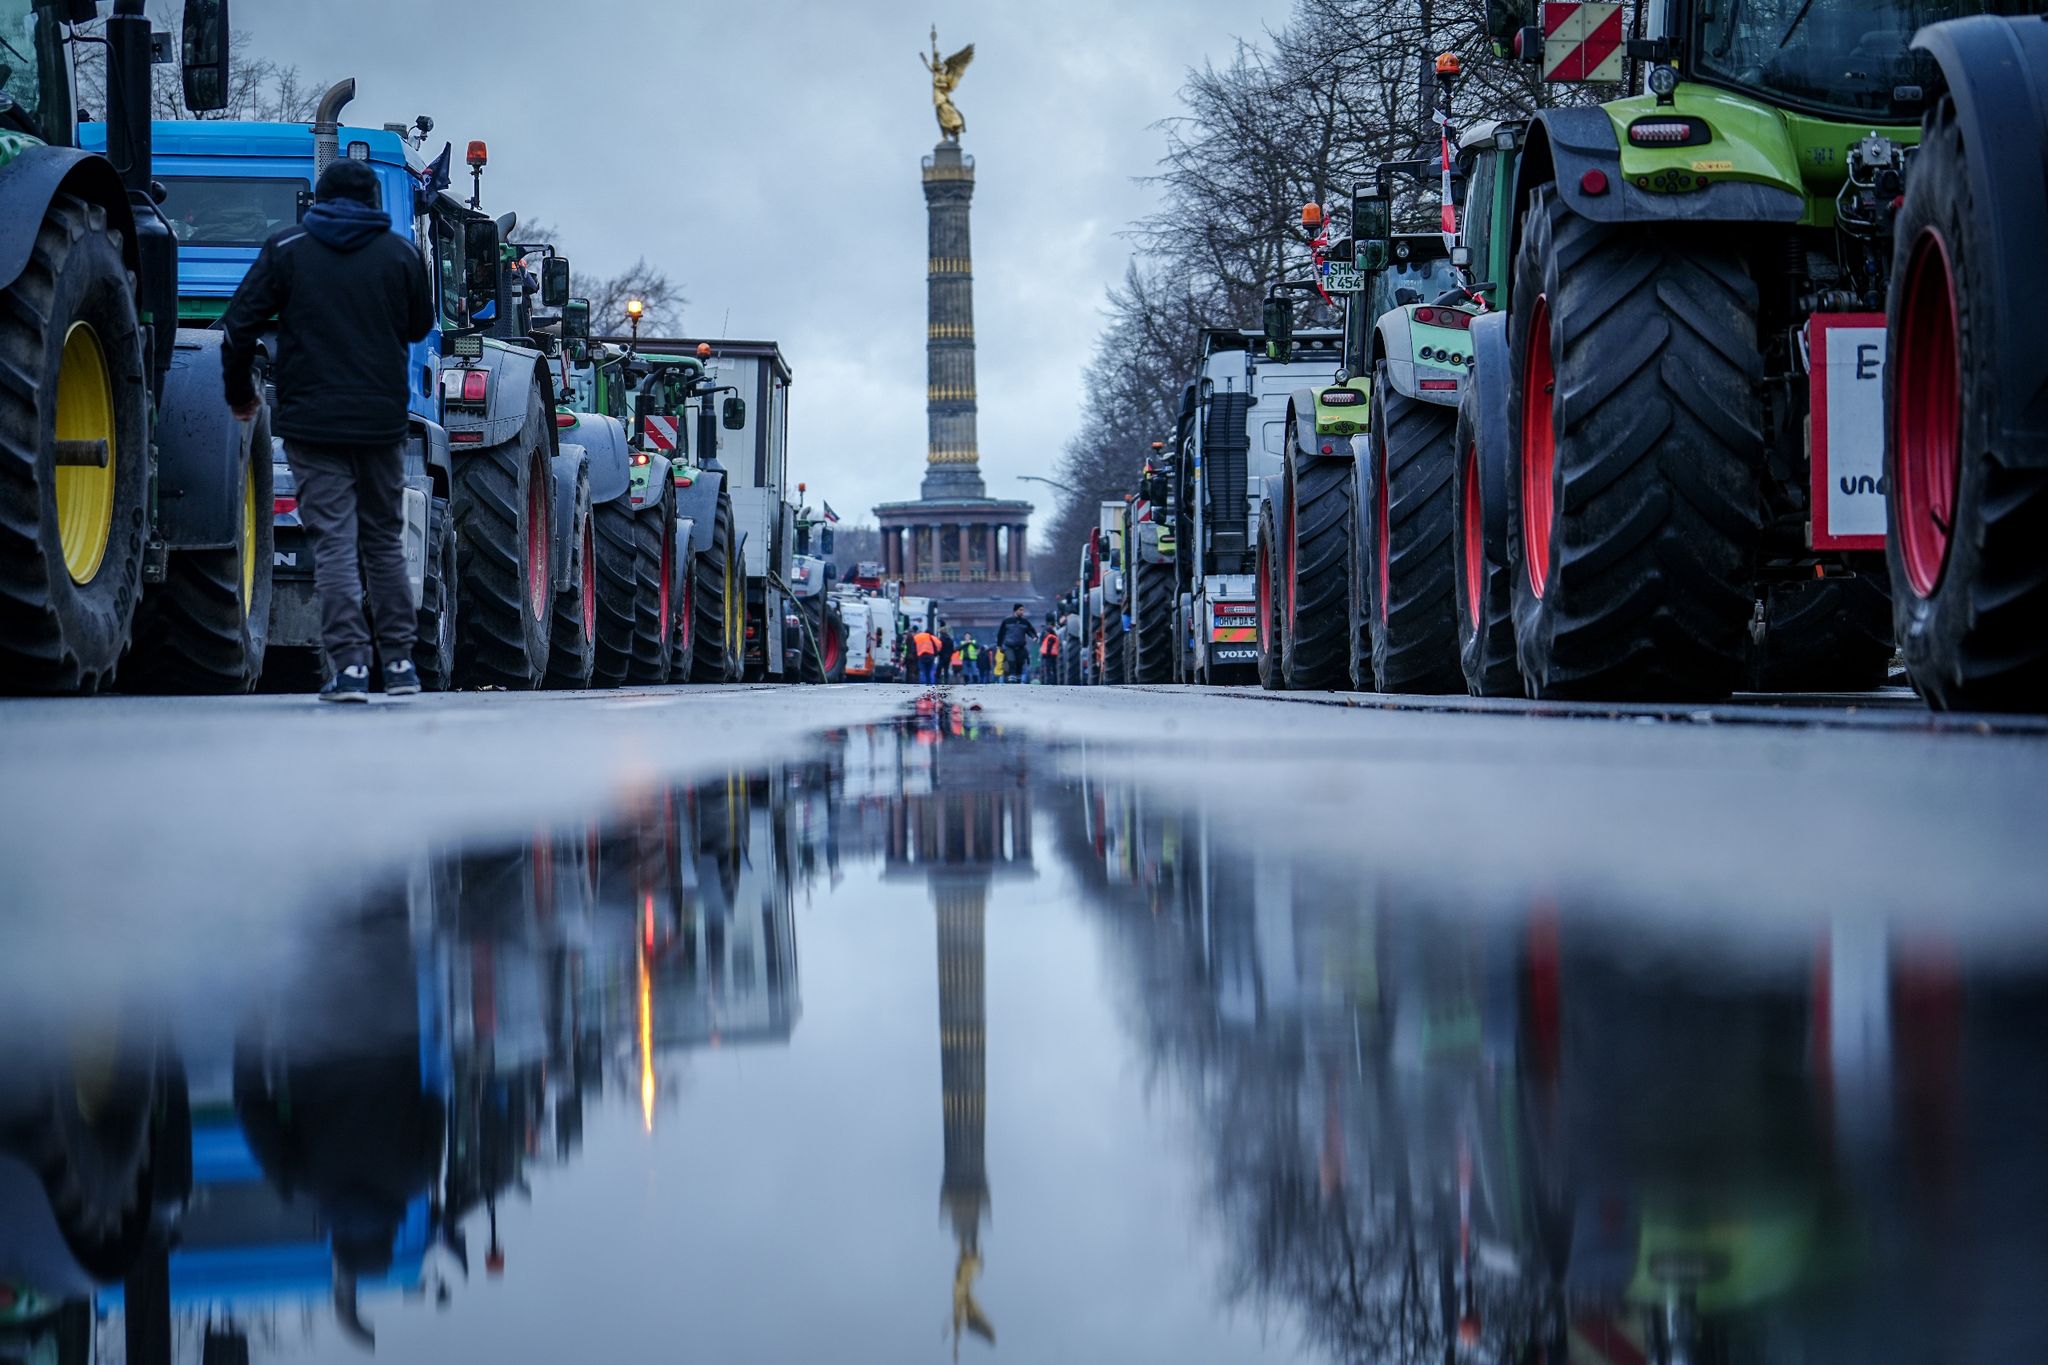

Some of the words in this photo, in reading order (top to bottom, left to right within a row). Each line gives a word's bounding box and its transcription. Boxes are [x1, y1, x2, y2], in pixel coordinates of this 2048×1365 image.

[1330, 262, 1355, 276] SHK
[1326, 276, 1335, 290] R
[1337, 276, 1361, 289] 454
